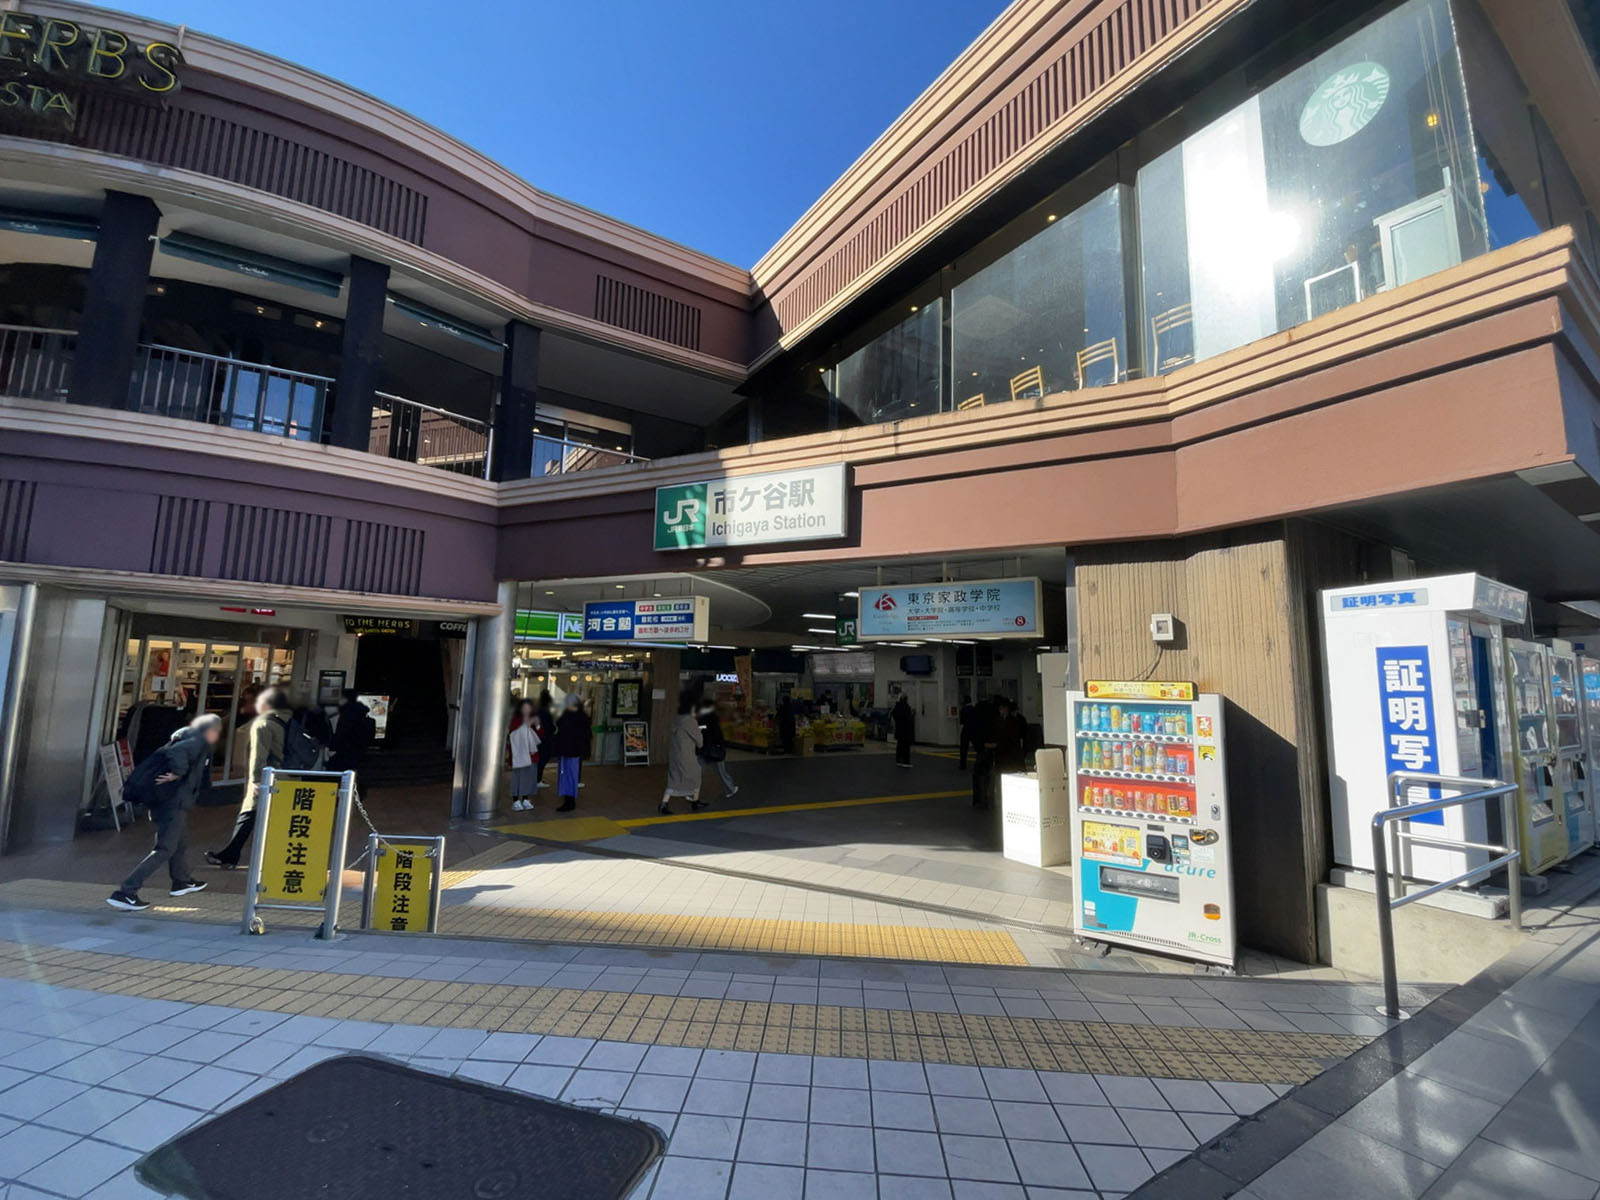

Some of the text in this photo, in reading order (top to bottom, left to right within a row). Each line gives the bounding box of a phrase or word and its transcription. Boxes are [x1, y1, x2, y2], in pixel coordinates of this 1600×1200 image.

[663, 498, 700, 524] JR
[712, 513, 826, 537] Ichigaya Station
[907, 588, 1001, 605] 東京家政学院
[1341, 592, 1416, 609] 証明写真
[357, 619, 374, 627] THE
[377, 619, 411, 629] HERBS
[587, 617, 631, 631] 河合塾
[838, 622, 855, 636] JR
[281, 788, 315, 894] 階段注意
[1164, 862, 1217, 879] acure
